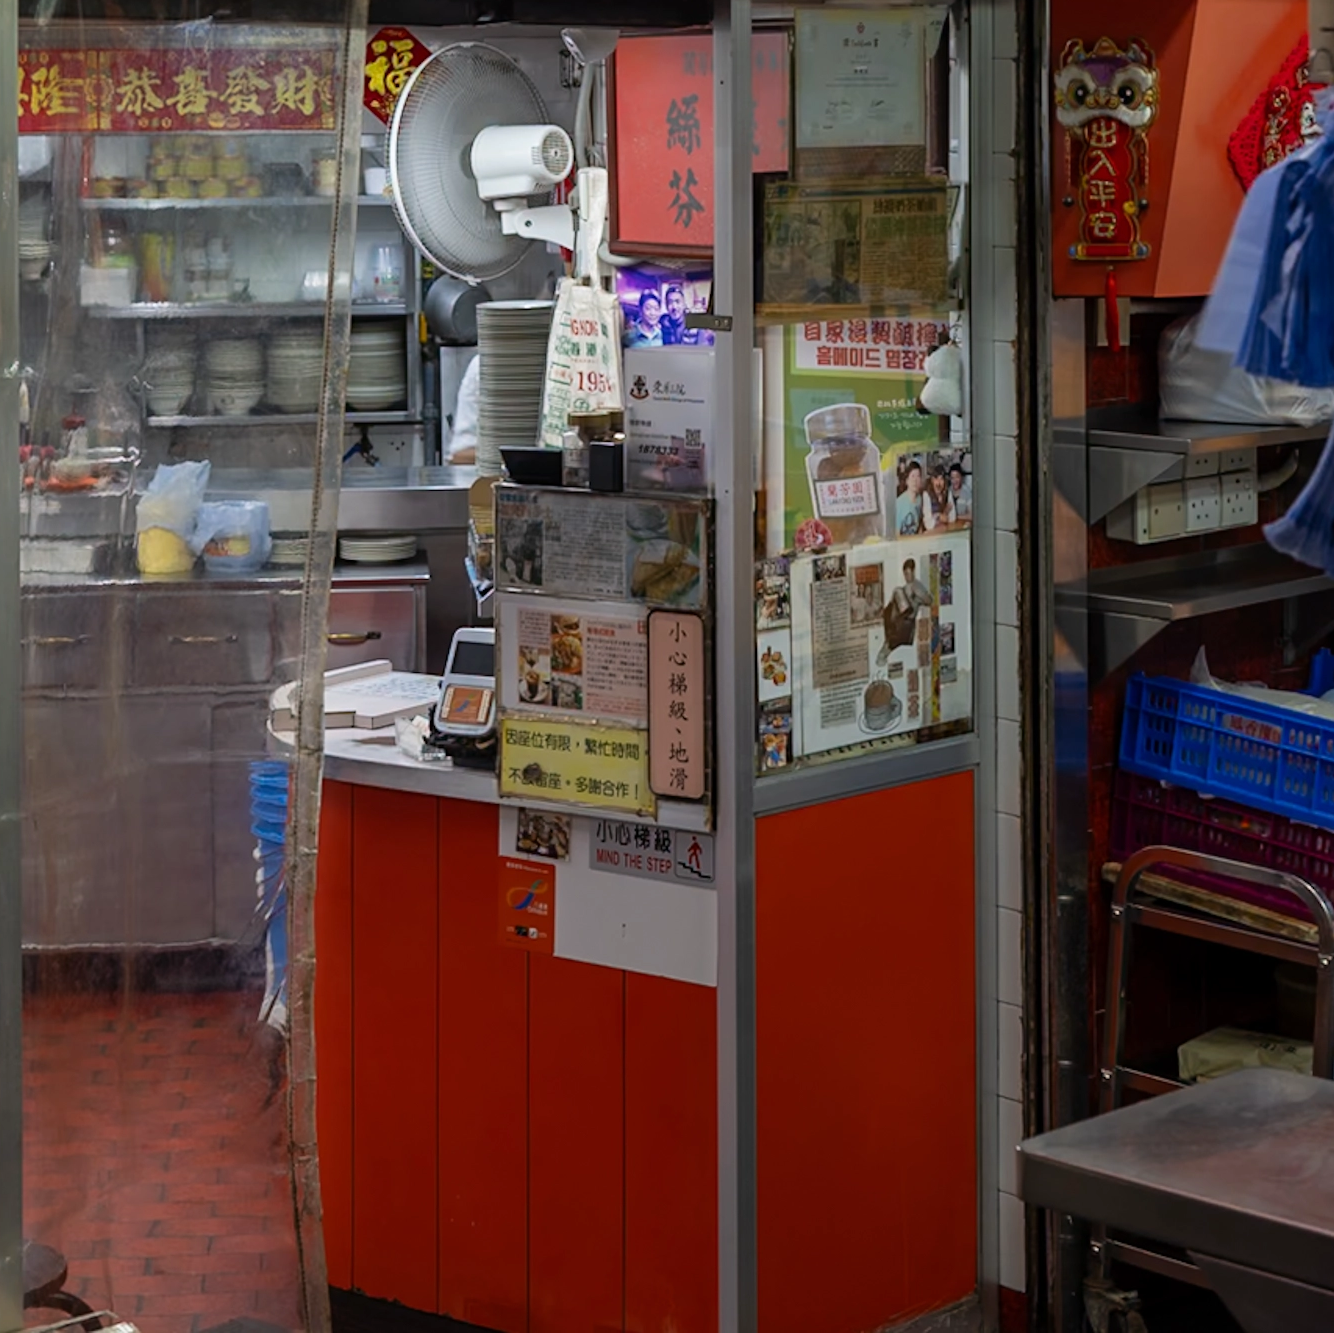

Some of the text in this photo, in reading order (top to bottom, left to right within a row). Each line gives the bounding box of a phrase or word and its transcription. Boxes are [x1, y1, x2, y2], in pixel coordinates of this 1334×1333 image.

[117, 66, 321, 115] 恭喜發財
[364, 39, 417, 95] 福
[1089, 120, 1116, 238] 出入平安
[668, 622, 689, 791] 小心梯級、地滑
[596, 821, 672, 854] 小心梯級
[596, 848, 672, 874] MIND THE STEP
